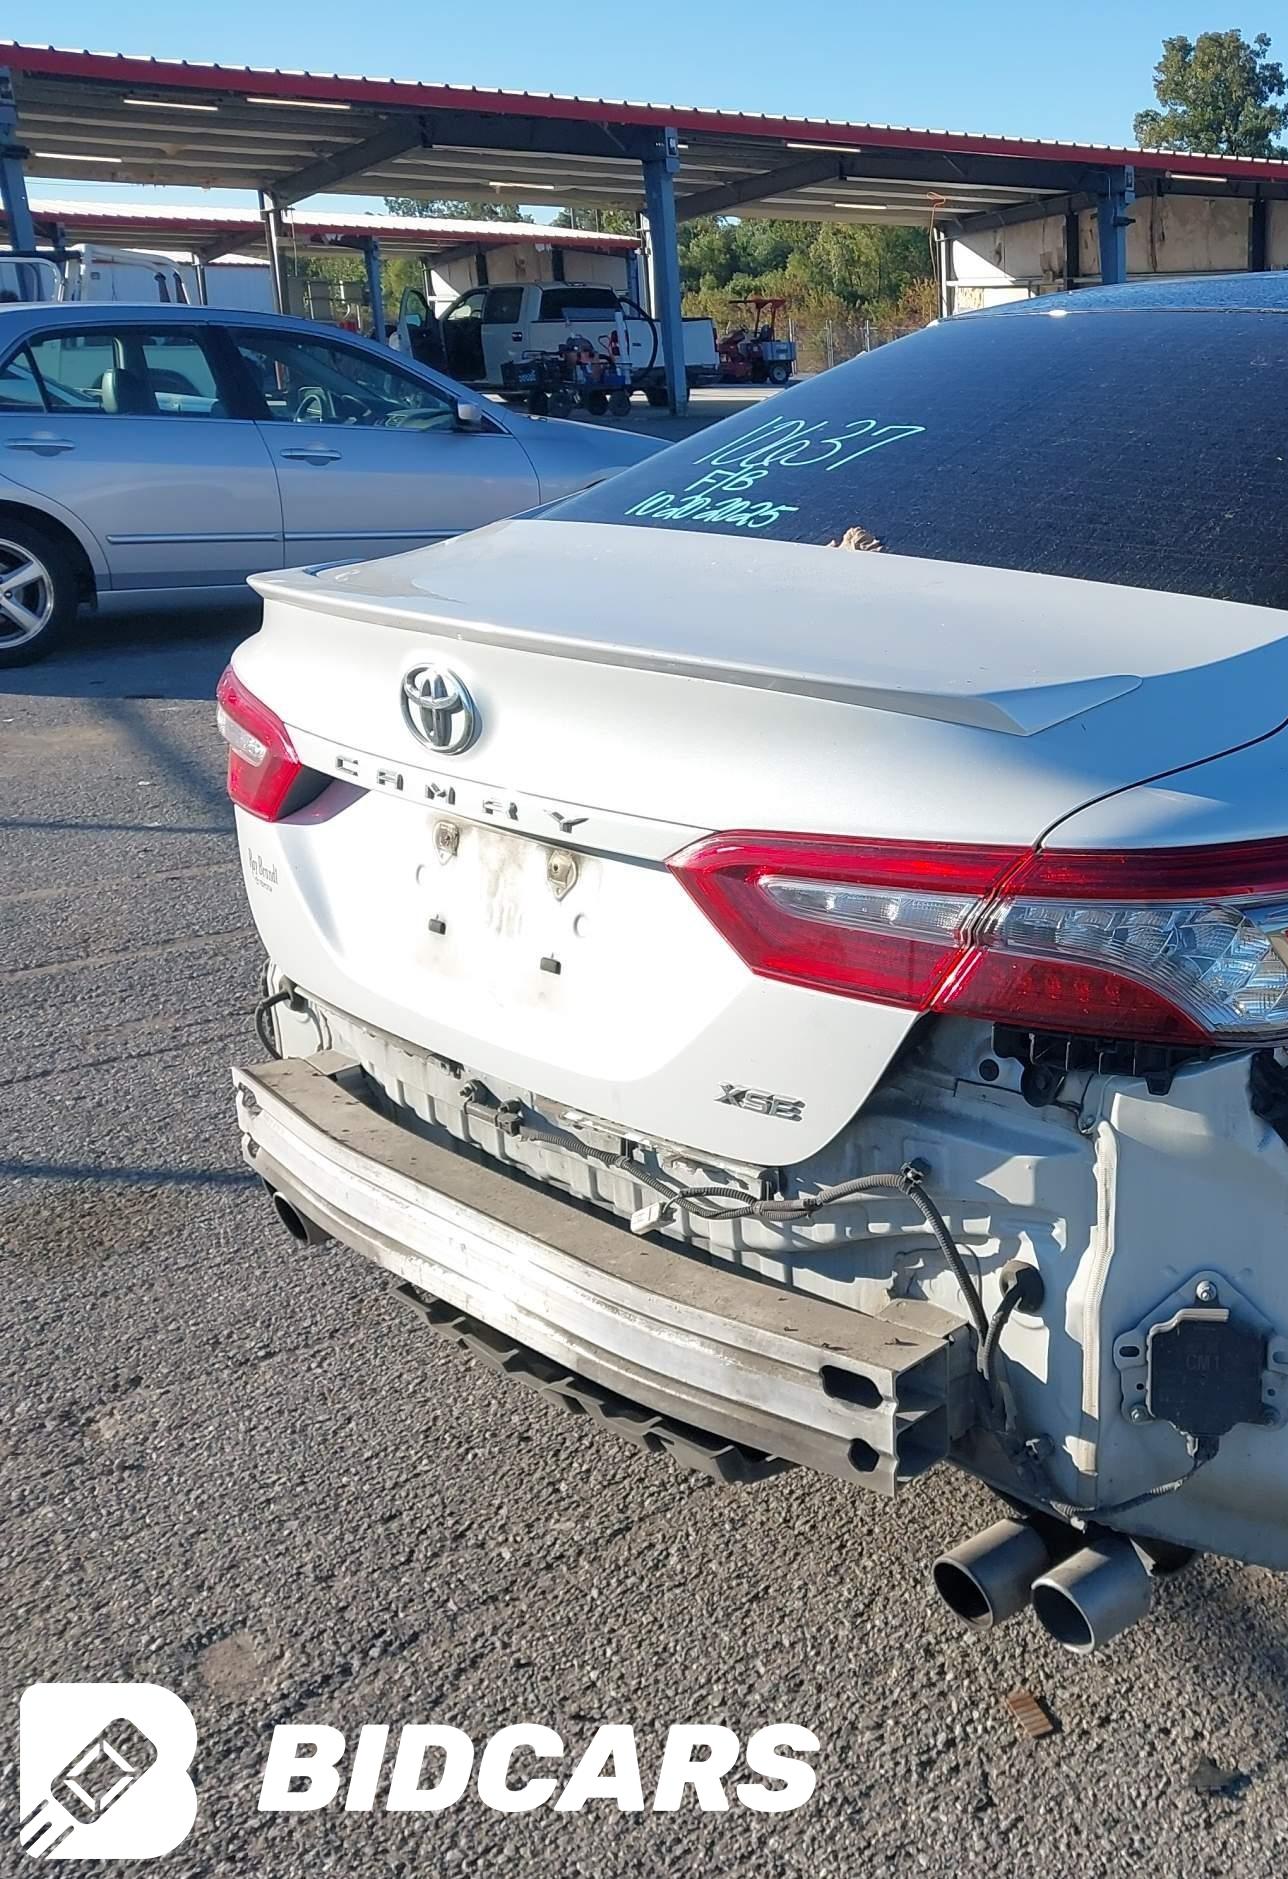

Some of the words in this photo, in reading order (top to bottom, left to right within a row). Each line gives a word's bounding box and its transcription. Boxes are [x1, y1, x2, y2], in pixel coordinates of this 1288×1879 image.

[693, 416, 926, 471] 10637
[336, 756, 589, 834] CAMRY
[713, 1083, 806, 1122] XSE
